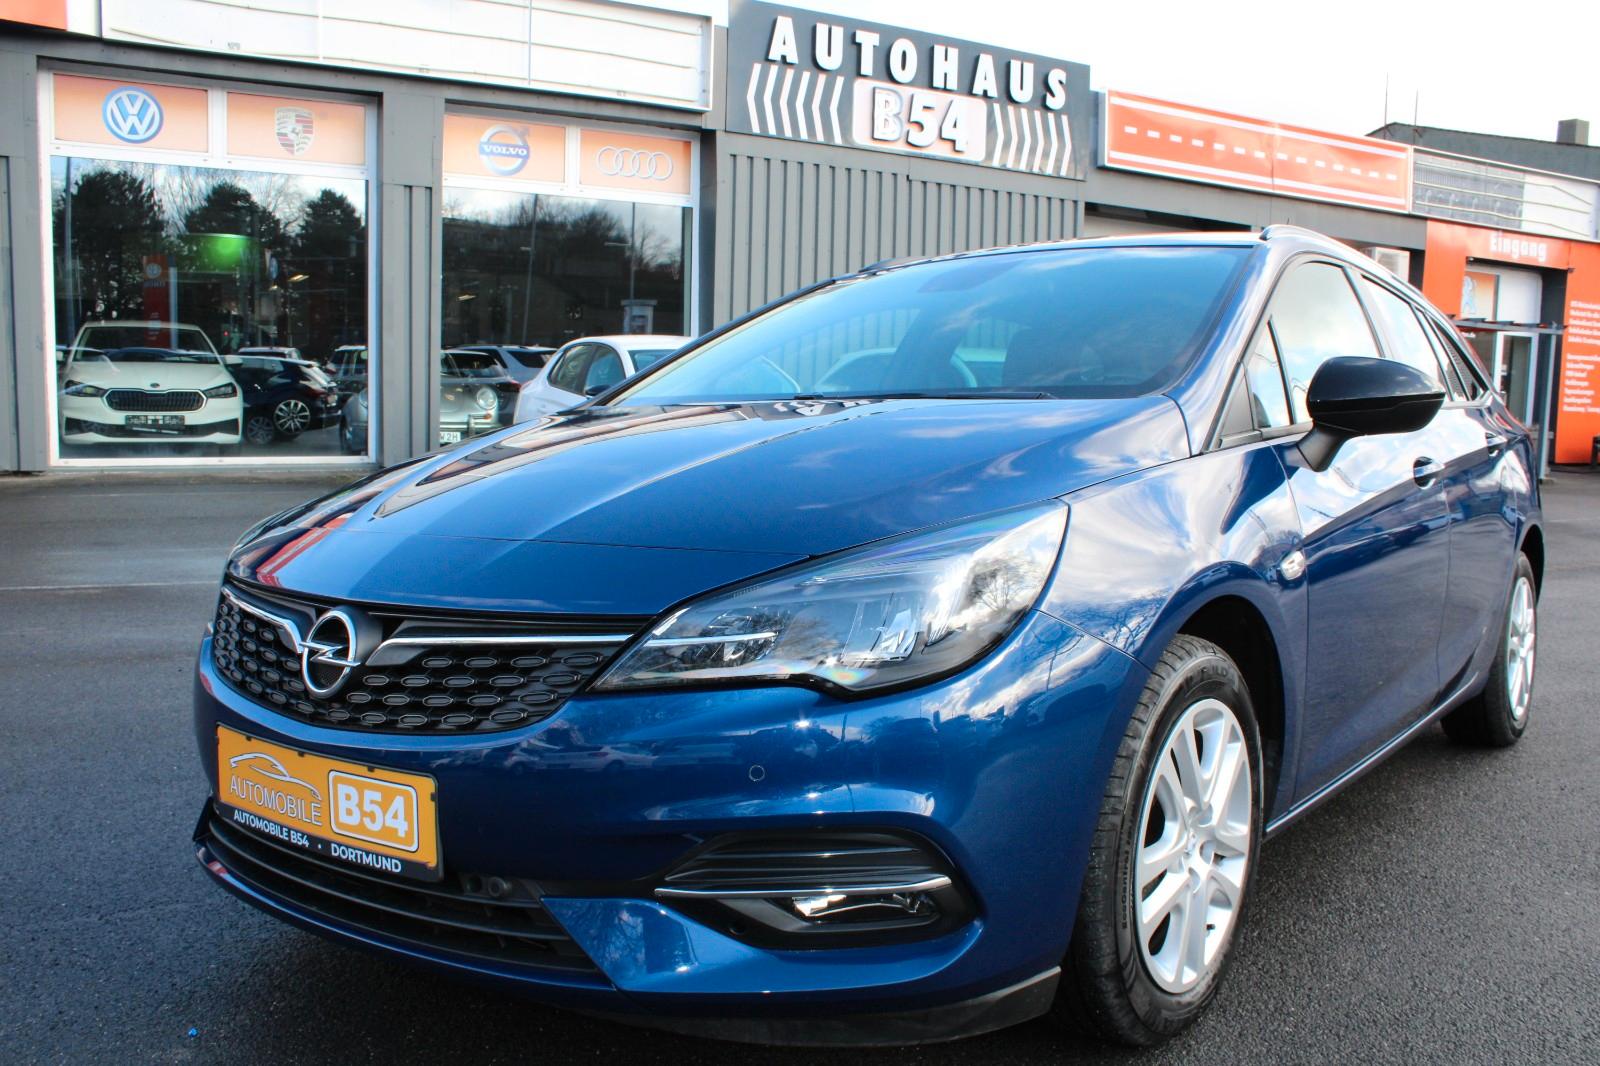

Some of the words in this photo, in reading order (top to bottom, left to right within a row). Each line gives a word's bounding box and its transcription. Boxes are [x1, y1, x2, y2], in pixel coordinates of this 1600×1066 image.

[768, 15, 1067, 111] AUTOHAUS
[483, 143, 528, 156] VOLVO
[871, 86, 969, 153] B54
[1489, 231, 1547, 262] Eingang
[229, 775, 323, 827] AUTOMOBILE
[337, 783, 409, 839] B54
[233, 809, 290, 842] AUTOMOBILE
[290, 830, 310, 849] B54
[331, 843, 402, 873] DORTMUND
